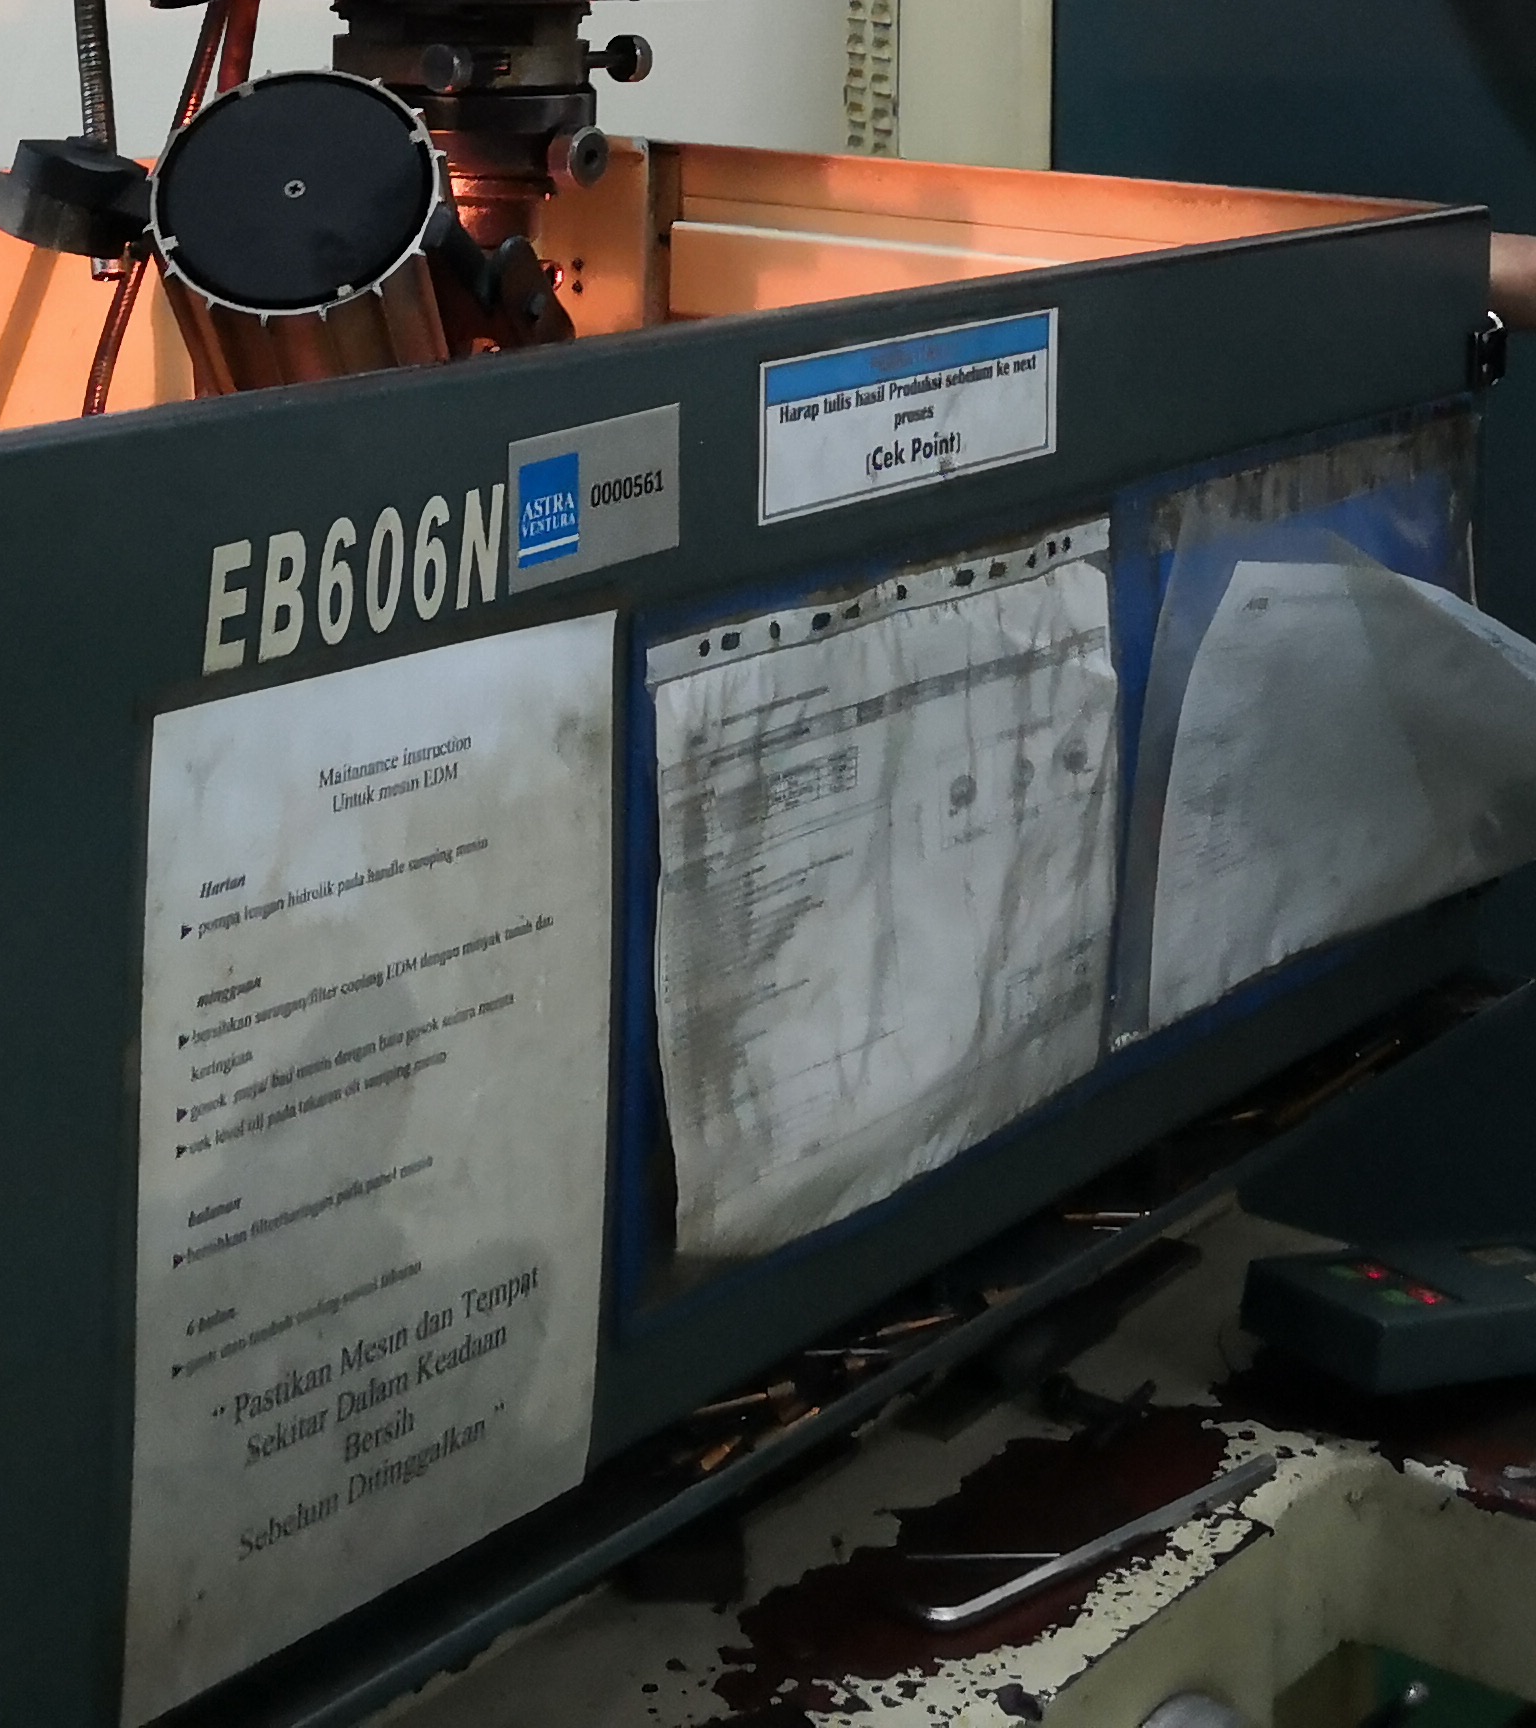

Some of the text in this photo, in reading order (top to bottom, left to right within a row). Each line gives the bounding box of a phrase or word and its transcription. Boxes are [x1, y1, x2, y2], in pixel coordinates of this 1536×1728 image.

[780, 404, 819, 423] Harap
[824, 393, 851, 414] tulis
[855, 385, 885, 407] hasil
[889, 373, 942, 400] Produksi
[997, 362, 1010, 377] ke
[1013, 355, 1036, 373] next
[523, 492, 574, 522] ASTRA
[590, 470, 664, 507] 0000561
[522, 513, 575, 538] VENTURA
[203, 484, 504, 677] EB606N
[402, 736, 471, 766] instruction
[333, 785, 374, 813] Untuk
[424, 762, 458, 788] EDM
[234, 1364, 332, 1425] Pastikan
[340, 1328, 410, 1375] Mesin
[415, 1308, 453, 1341] dan
[462, 1267, 538, 1318] Tempat
[245, 1324, 507, 1469] Sekitar Dalam Keadaan
[344, 1406, 417, 1464] Bersih
[238, 1493, 341, 1563] Sebelum
